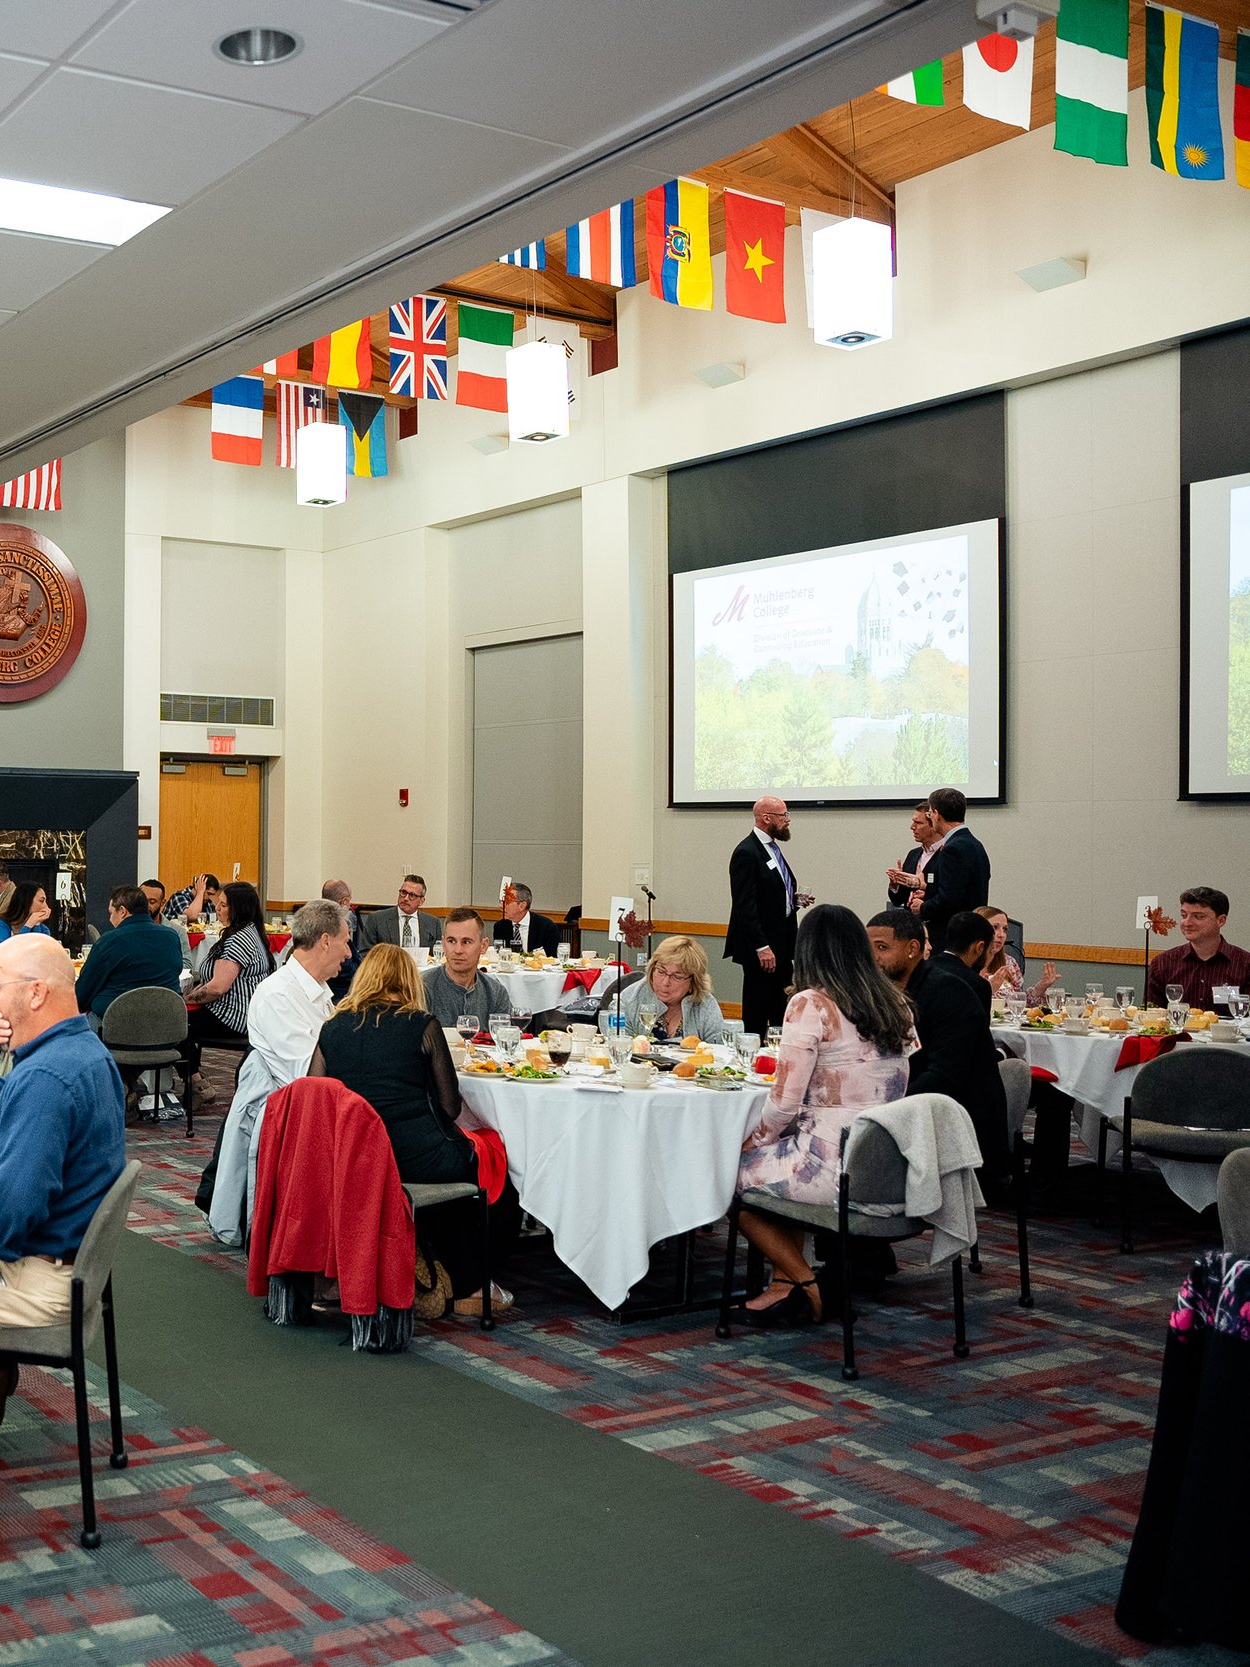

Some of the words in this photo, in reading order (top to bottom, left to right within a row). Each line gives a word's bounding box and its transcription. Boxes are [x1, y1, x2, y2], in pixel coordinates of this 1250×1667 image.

[753, 587, 815, 604] Muhlenberg
[753, 604, 790, 618] College
[24, 622, 63, 668] COLLEGE
[793, 637, 831, 649] Education
[213, 738, 234, 753] EXIT
[60, 880, 67, 889] 6
[617, 907, 626, 919] 7
